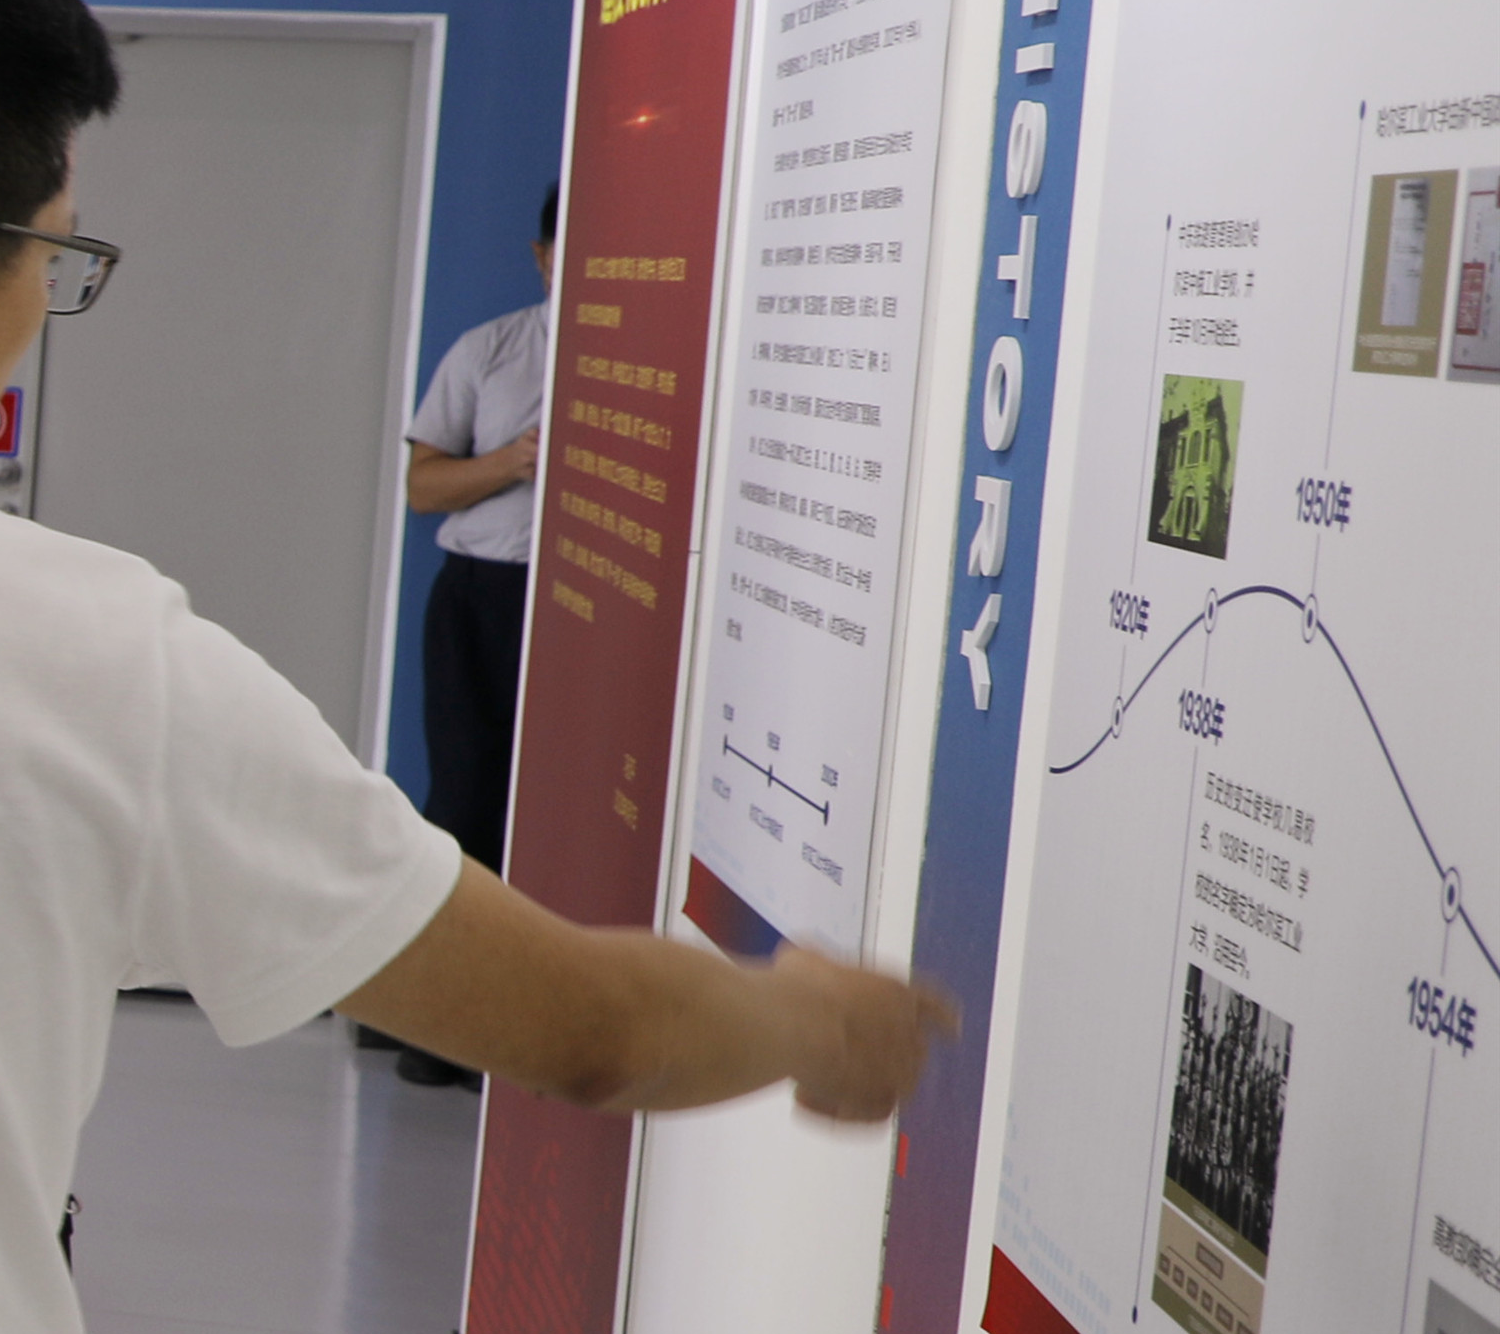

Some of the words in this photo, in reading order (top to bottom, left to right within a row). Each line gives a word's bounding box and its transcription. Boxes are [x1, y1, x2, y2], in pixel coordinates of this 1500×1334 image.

[1295, 477, 1353, 533] 1950年
[1109, 588, 1151, 641] 1920年
[1177, 687, 1226, 747] 1938年
[1407, 975, 1477, 1059] 1954年
